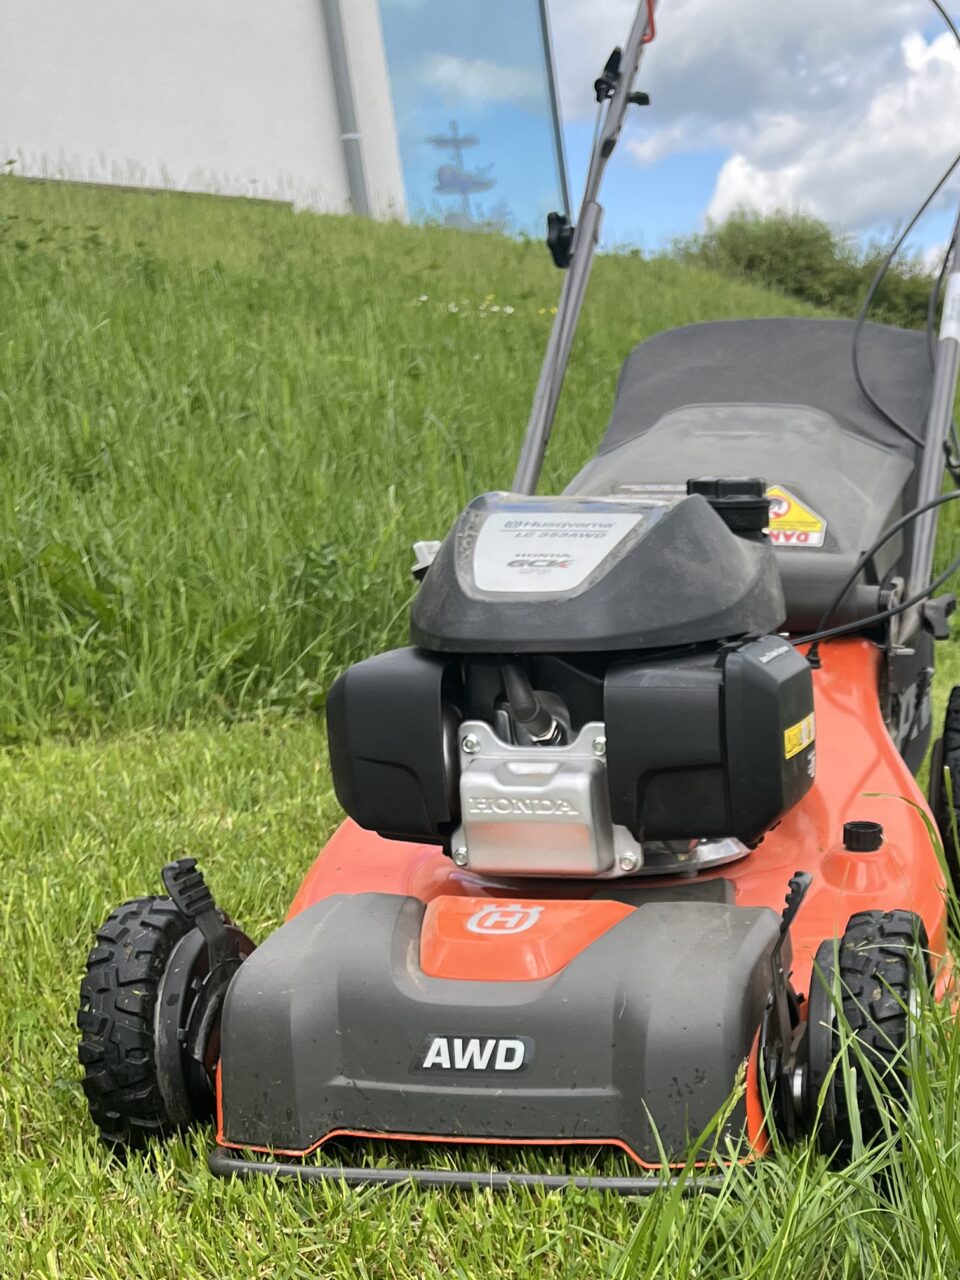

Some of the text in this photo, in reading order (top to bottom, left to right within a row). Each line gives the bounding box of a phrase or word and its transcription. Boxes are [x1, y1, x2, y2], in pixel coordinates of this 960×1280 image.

[523, 520, 613, 529] Husqvarna
[468, 798, 579, 815] HONDA
[422, 1038, 525, 1070] AWD
